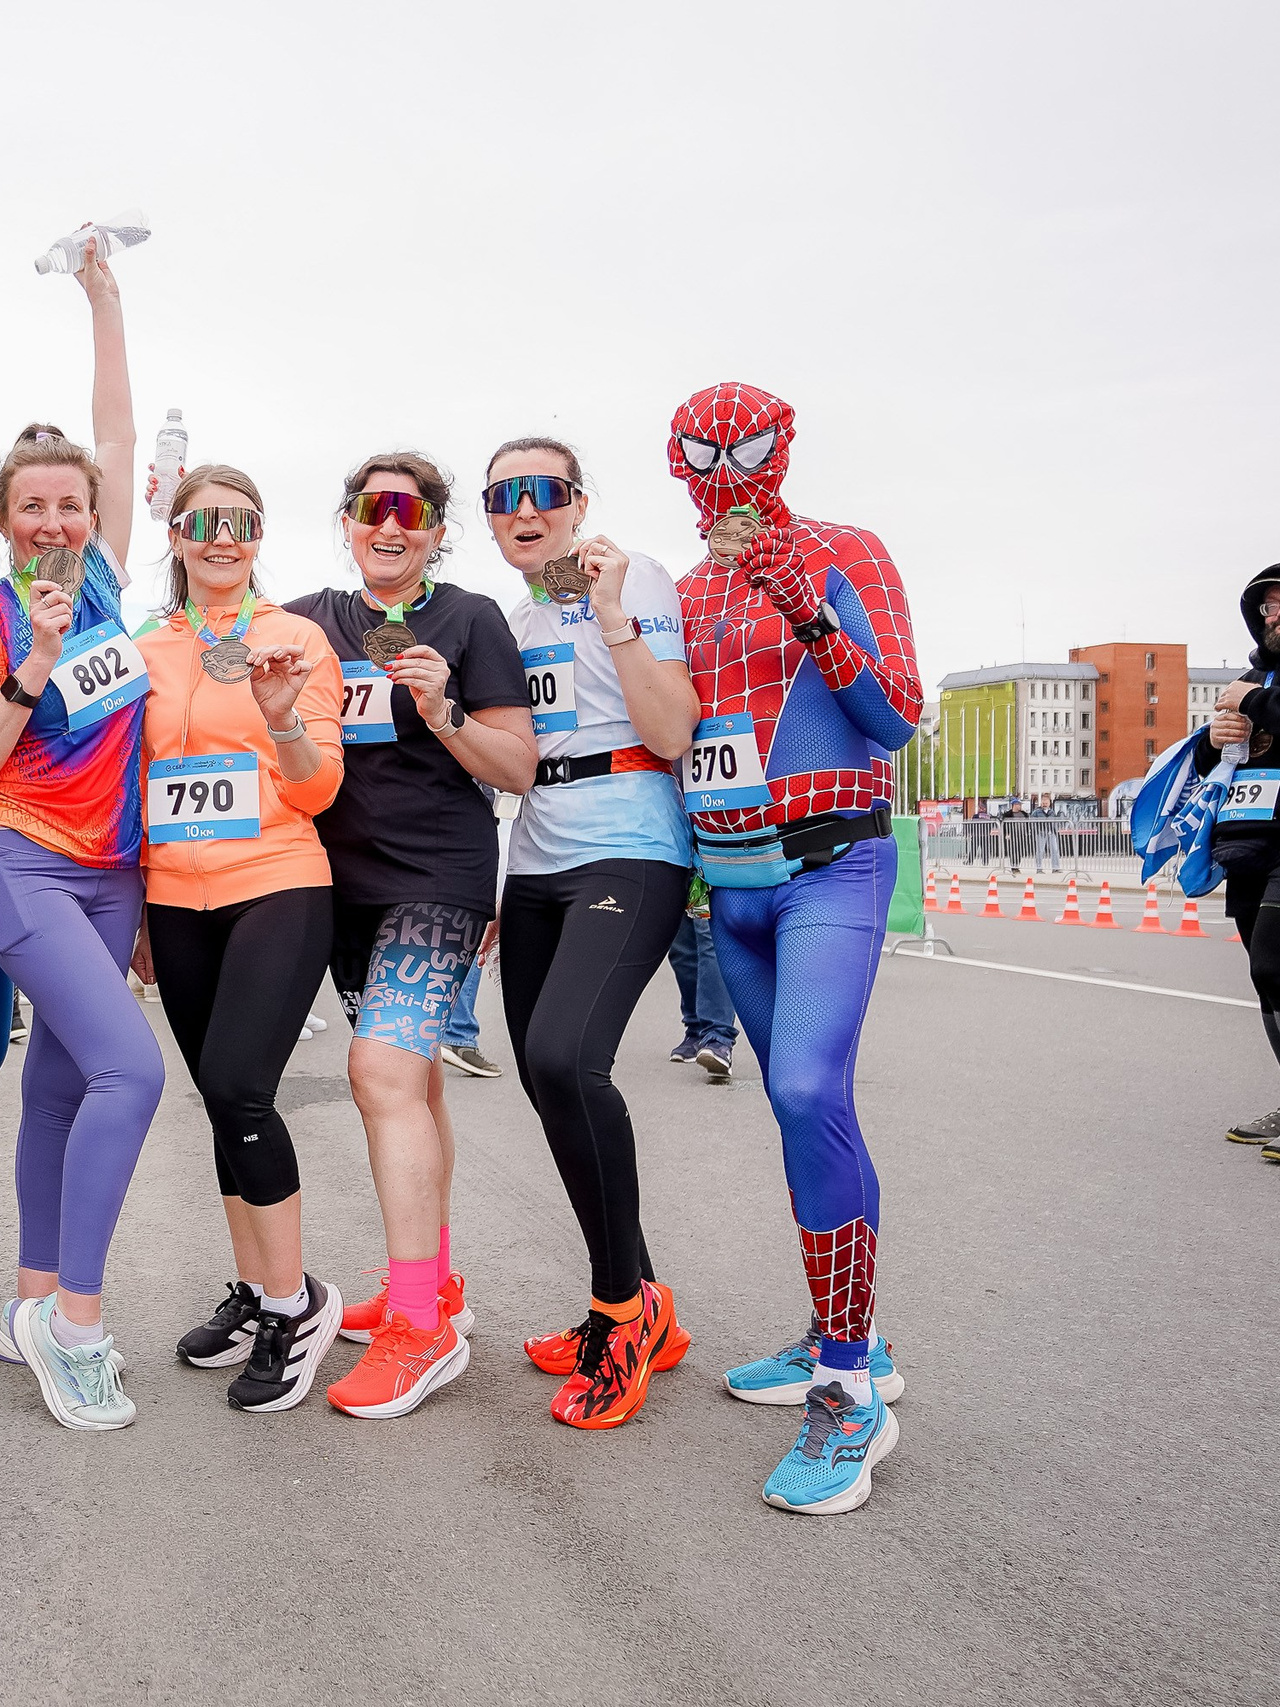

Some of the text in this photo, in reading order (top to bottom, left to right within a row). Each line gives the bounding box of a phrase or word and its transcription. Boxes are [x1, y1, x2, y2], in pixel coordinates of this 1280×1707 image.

[72, 647, 130, 696] 802
[691, 743, 738, 783] 570
[166, 779, 234, 816] 790
[588, 904, 625, 914] DEMIX
